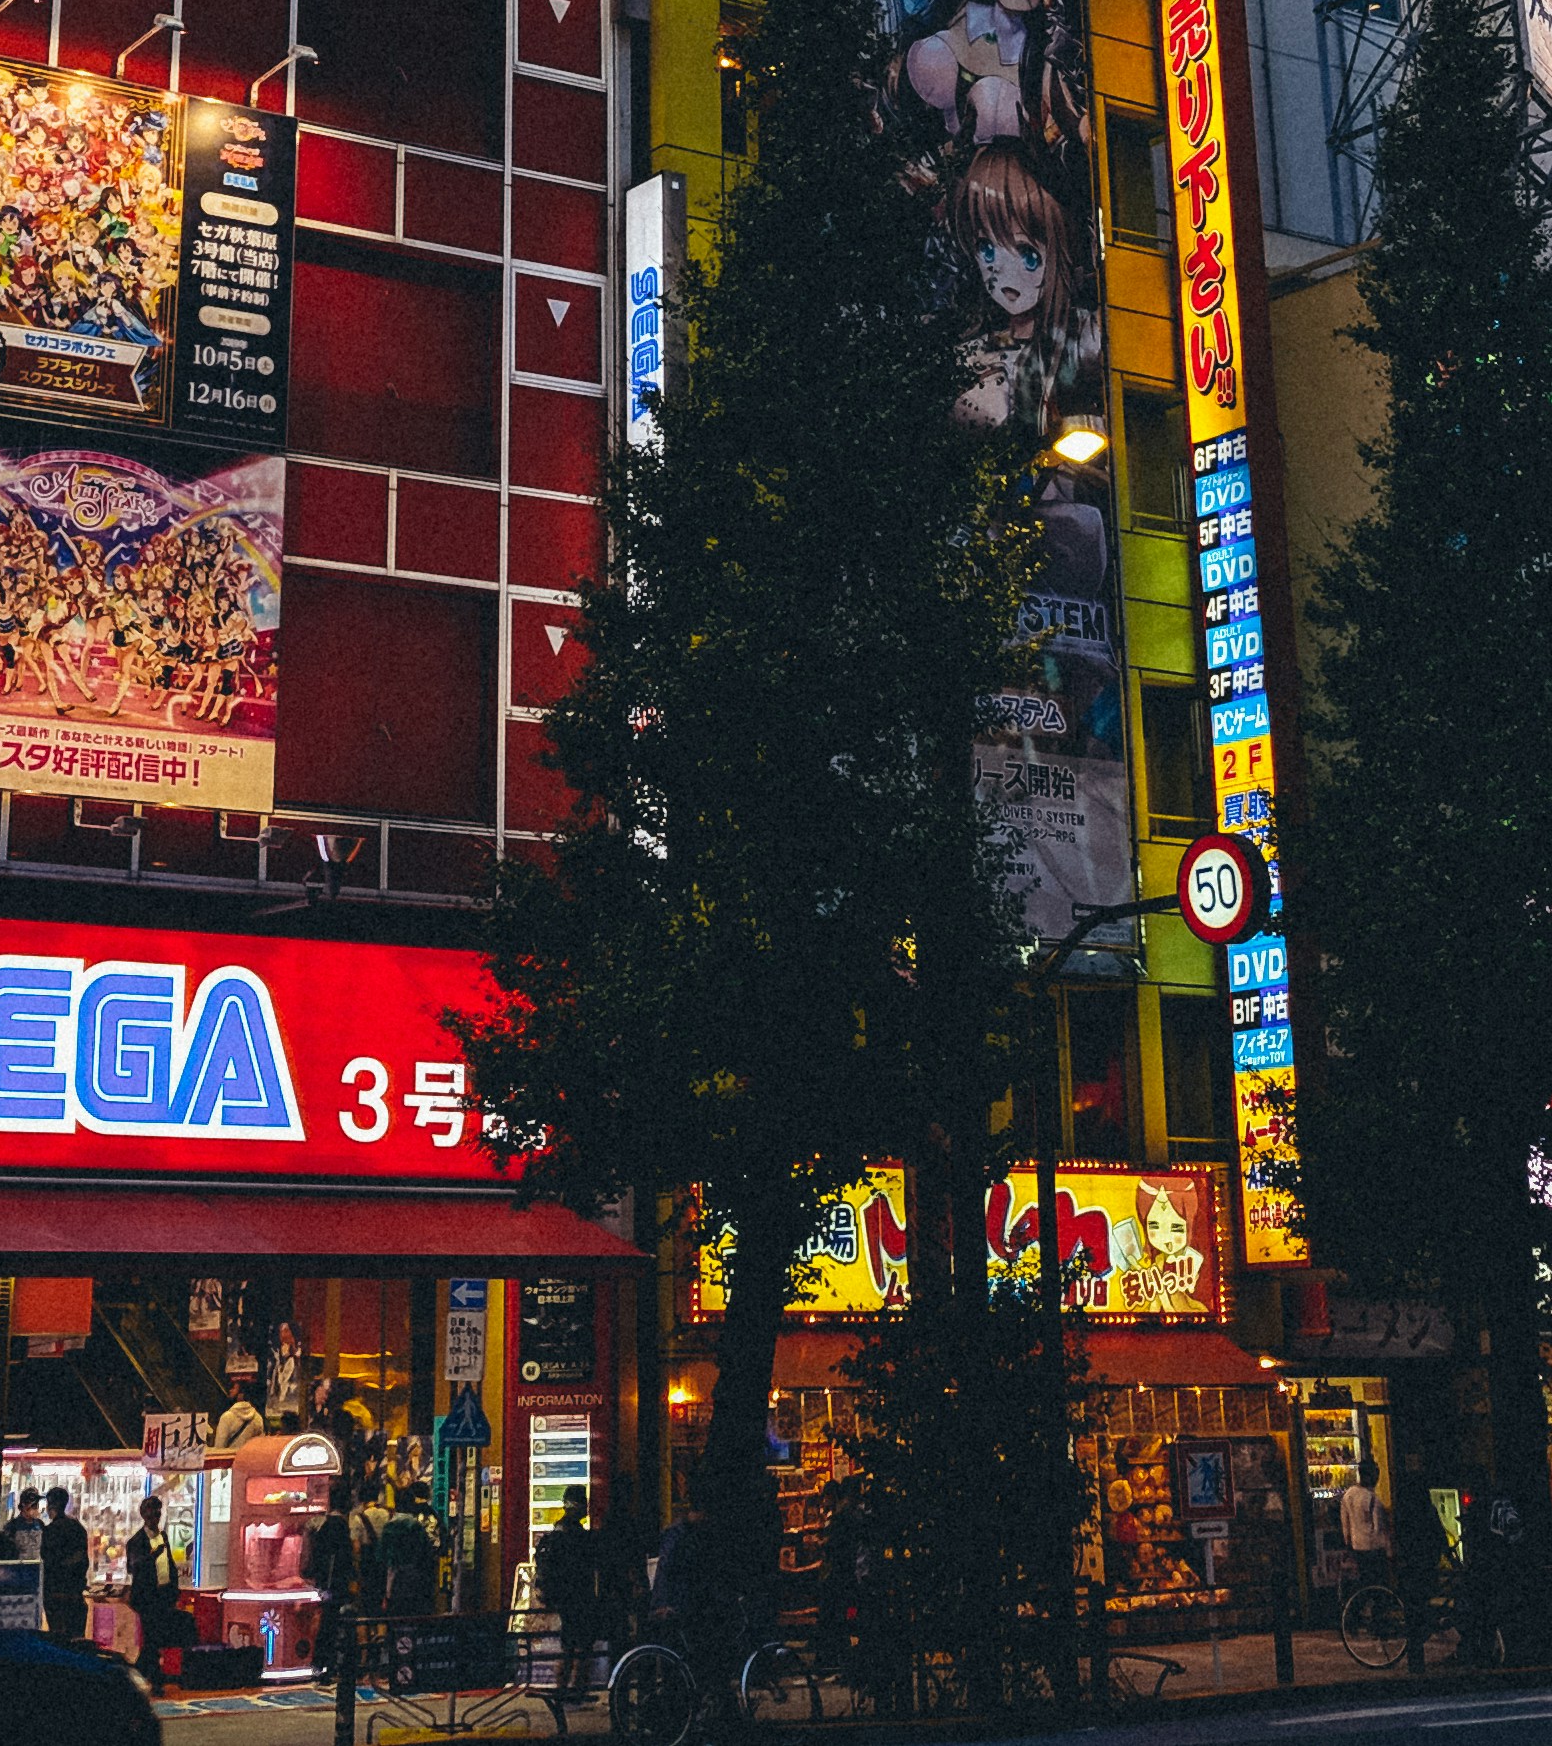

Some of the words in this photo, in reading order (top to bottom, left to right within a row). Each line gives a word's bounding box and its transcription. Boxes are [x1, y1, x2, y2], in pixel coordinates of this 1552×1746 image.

[198, 221, 278, 251] セガ秋葉原
[630, 267, 661, 422] SEGA
[1194, 445, 1217, 472] 6F
[1217, 433, 1247, 466] 中古
[1201, 481, 1246, 514] DVD
[1199, 517, 1220, 547] 5F
[1220, 508, 1252, 541] 中古
[1206, 546, 1234, 563] ADULT
[1206, 554, 1253, 590] DVD
[1023, 594, 1107, 643] STEM
[1205, 595, 1228, 623] 4F
[1228, 584, 1259, 618] 中古
[1212, 630, 1260, 667] DVD
[1213, 623, 1242, 641] ADULT
[1209, 671, 1231, 700] 3F
[1232, 662, 1264, 694] 中古
[1213, 703, 1269, 740] PCゲーム
[1195, 862, 1238, 914] 50
[1233, 947, 1286, 988] DVD
[1232, 996, 1260, 1026] B1F
[1261, 991, 1289, 1022] 中古
[1235, 1030, 1289, 1055] フィギュア
[339, 1054, 508, 1151] 3号
[1119, 1257, 1199, 1311] 安いっ!!
[517, 1394, 603, 1407] INFORMATION
